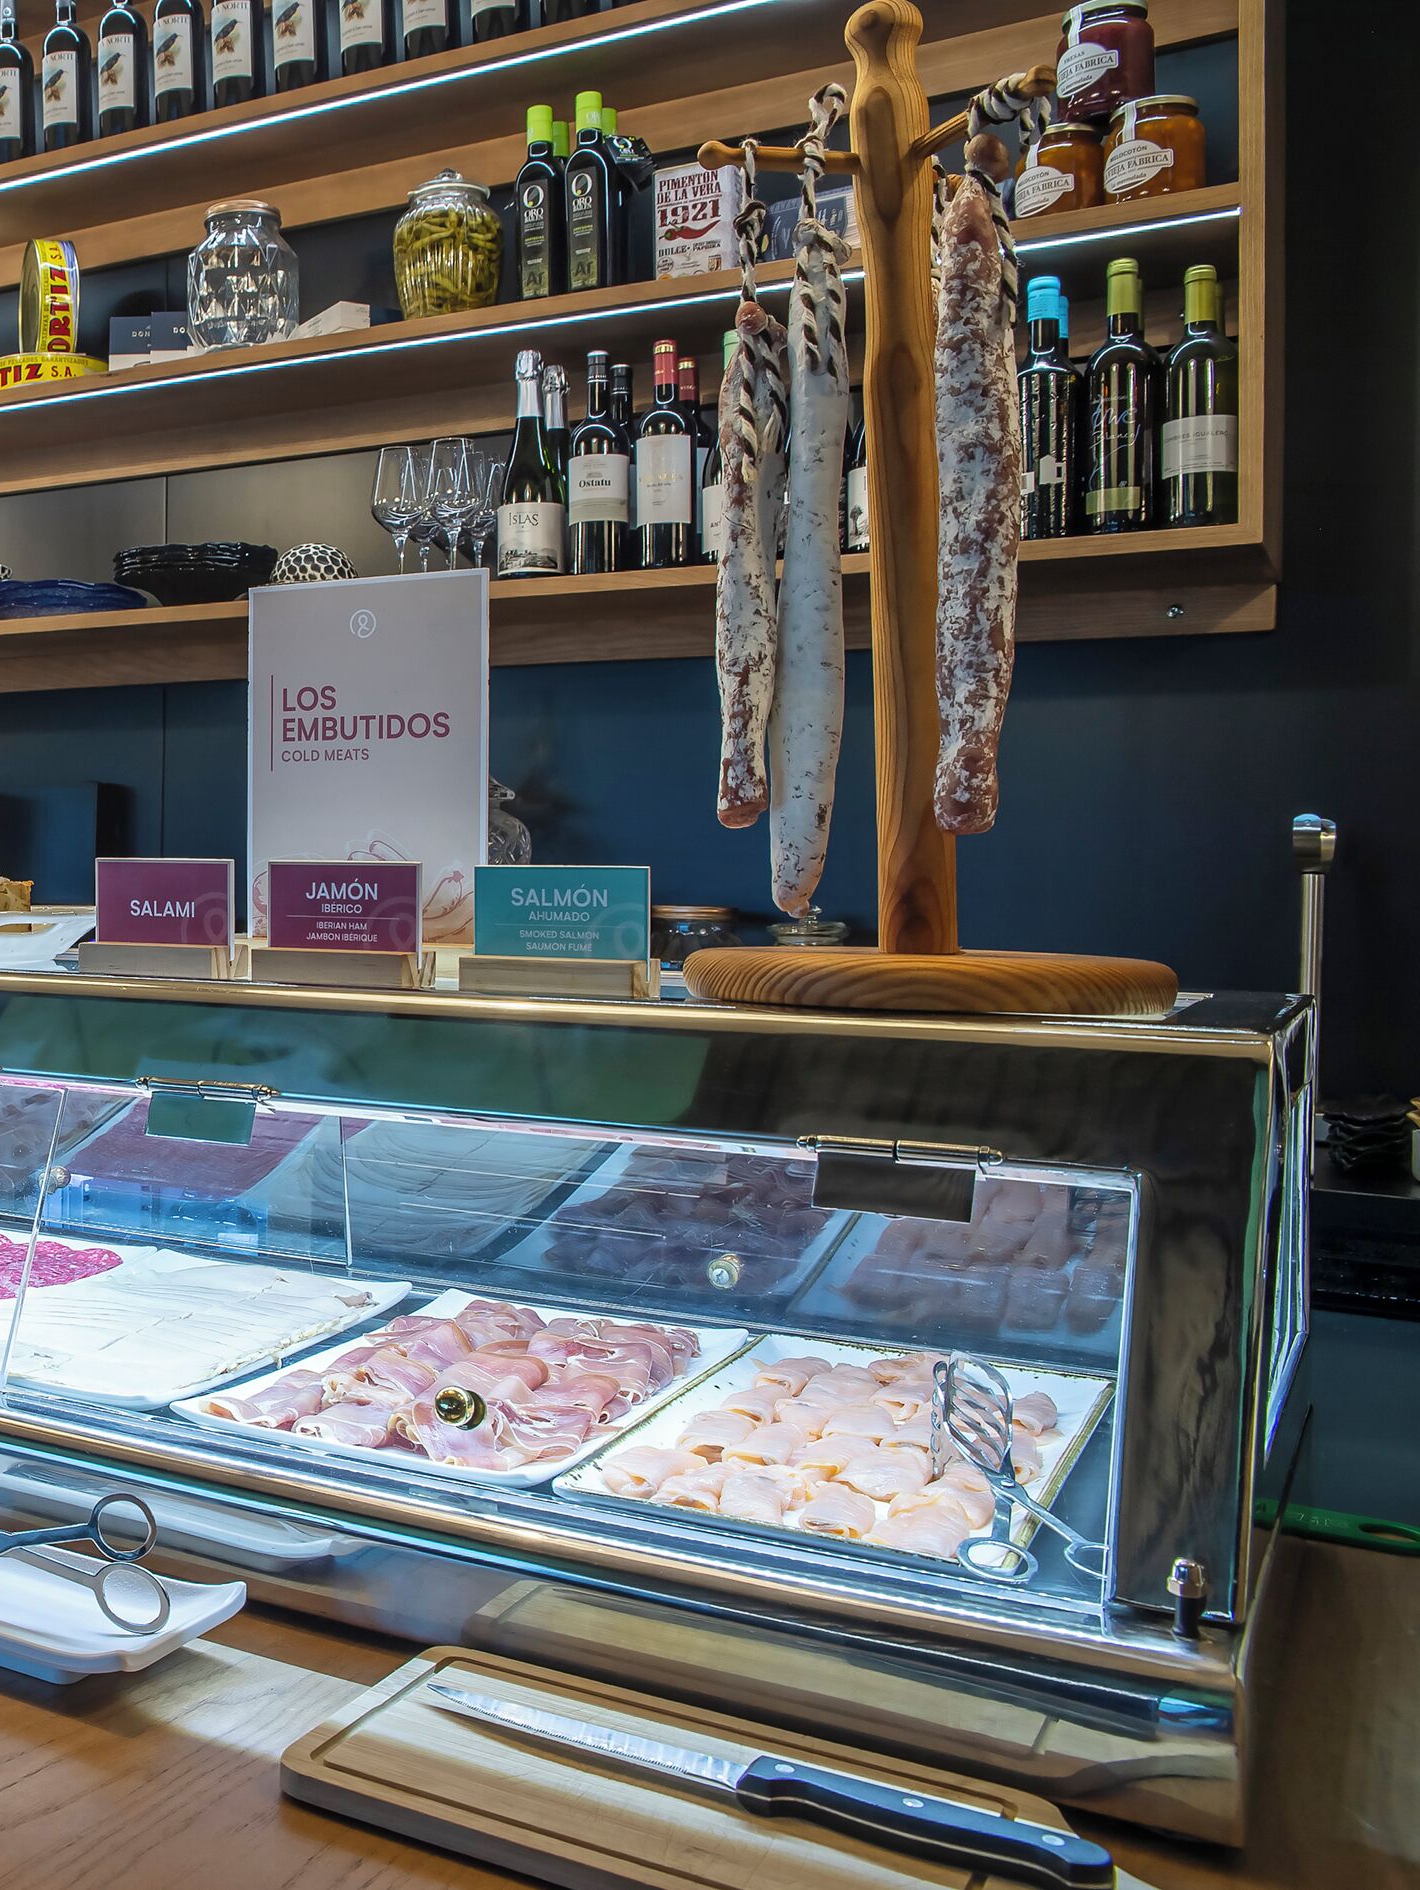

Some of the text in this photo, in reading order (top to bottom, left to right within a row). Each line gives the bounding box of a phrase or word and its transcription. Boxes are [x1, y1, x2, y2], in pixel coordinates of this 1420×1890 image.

[162, 16, 188, 25] NORTE
[107, 35, 131, 44] NORTE
[50, 53, 74, 61] NORTE
[657, 191, 671, 205] DE
[675, 188, 688, 202] LA
[692, 182, 721, 198] VERA
[658, 198, 722, 228] 1921
[658, 245, 687, 257] DULCE
[47, 266, 71, 353] ORTIZ
[51, 365, 77, 378] S.A.
[578, 478, 611, 489] Ostatu
[282, 685, 337, 712] LOS
[282, 712, 450, 742] EMBUTIDOS
[281, 748, 370, 763] COLD MEATS
[305, 878, 379, 901] JAMÓN
[510, 883, 608, 908] SALMÓN
[129, 899, 196, 918] SALAMI
[320, 901, 363, 914] IBÉRICO
[528, 911, 590, 922] AHUMADO
[316, 921, 368, 931] IBERIAN HAM
[306, 932, 341, 942] JAMBON
[519, 929, 600, 940] SMOKED SALMON
[525, 942, 593, 952] SAUMON FUMÉ
